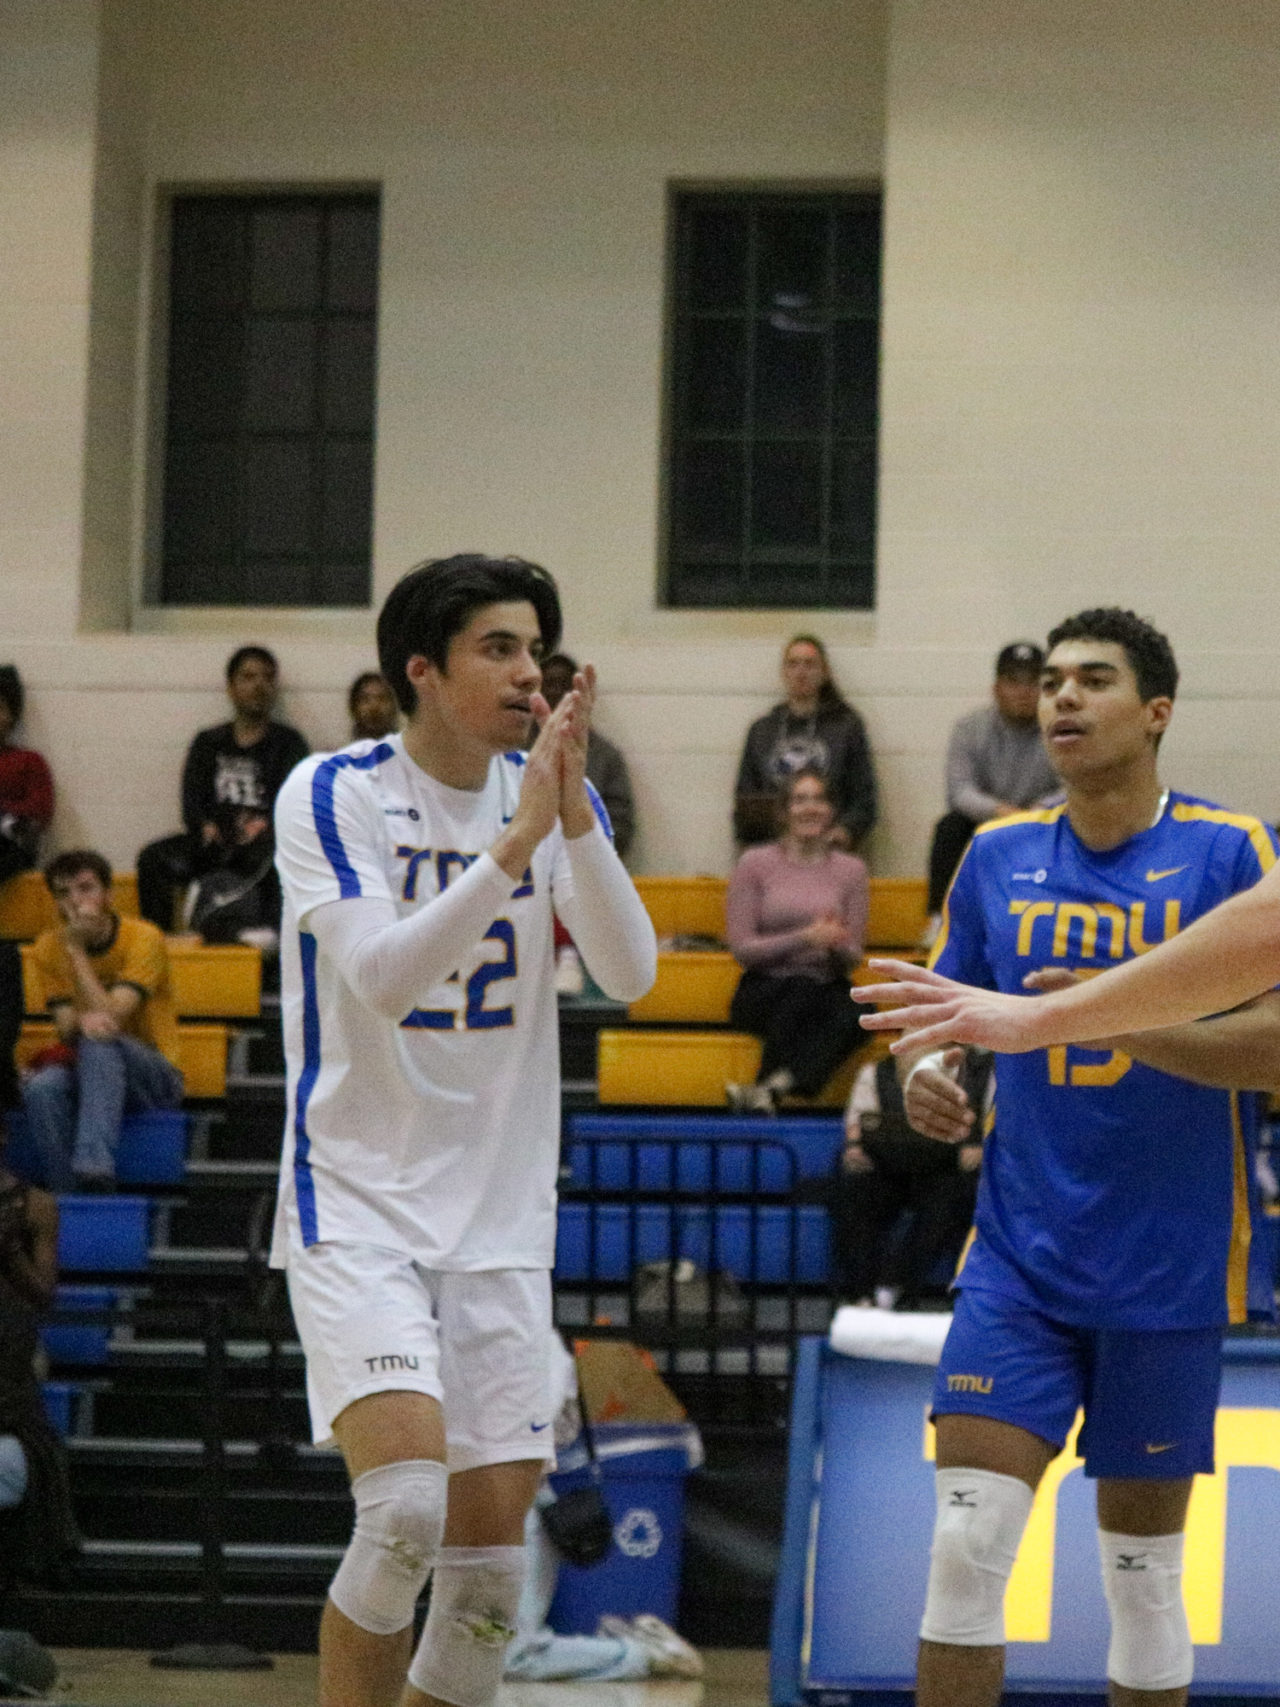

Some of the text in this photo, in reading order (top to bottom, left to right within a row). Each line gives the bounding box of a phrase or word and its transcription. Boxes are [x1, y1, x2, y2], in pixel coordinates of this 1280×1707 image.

[396, 844, 535, 901] TM
[1009, 899, 1182, 958] TMU
[364, 1355, 419, 1373] TMU
